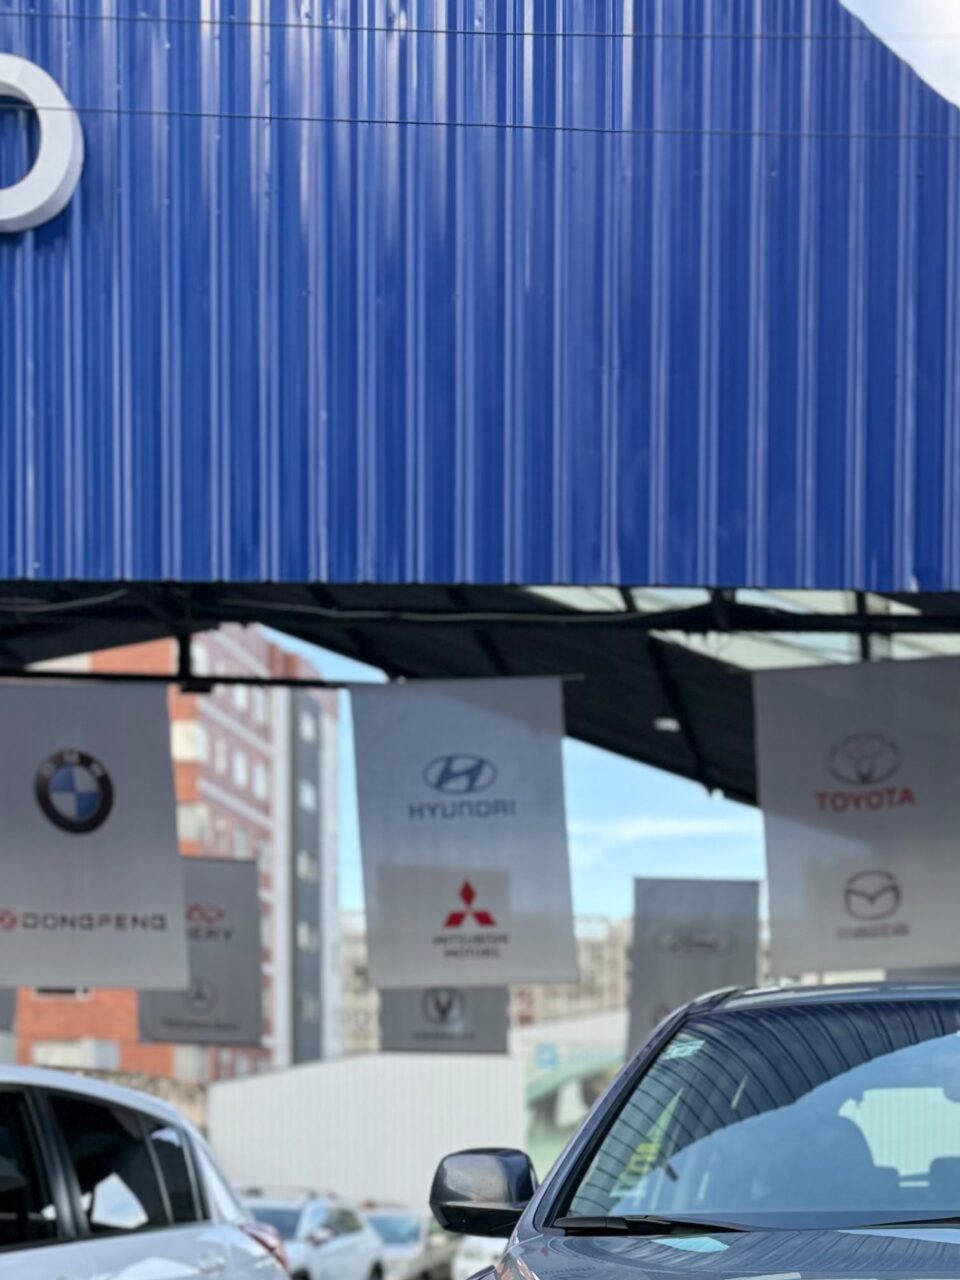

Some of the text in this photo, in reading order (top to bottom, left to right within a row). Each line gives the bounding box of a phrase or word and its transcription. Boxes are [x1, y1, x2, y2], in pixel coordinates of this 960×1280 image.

[815, 786, 915, 812] TOYOTA
[408, 800, 517, 820] HYUNDAI
[21, 912, 168, 932] DONGFENG
